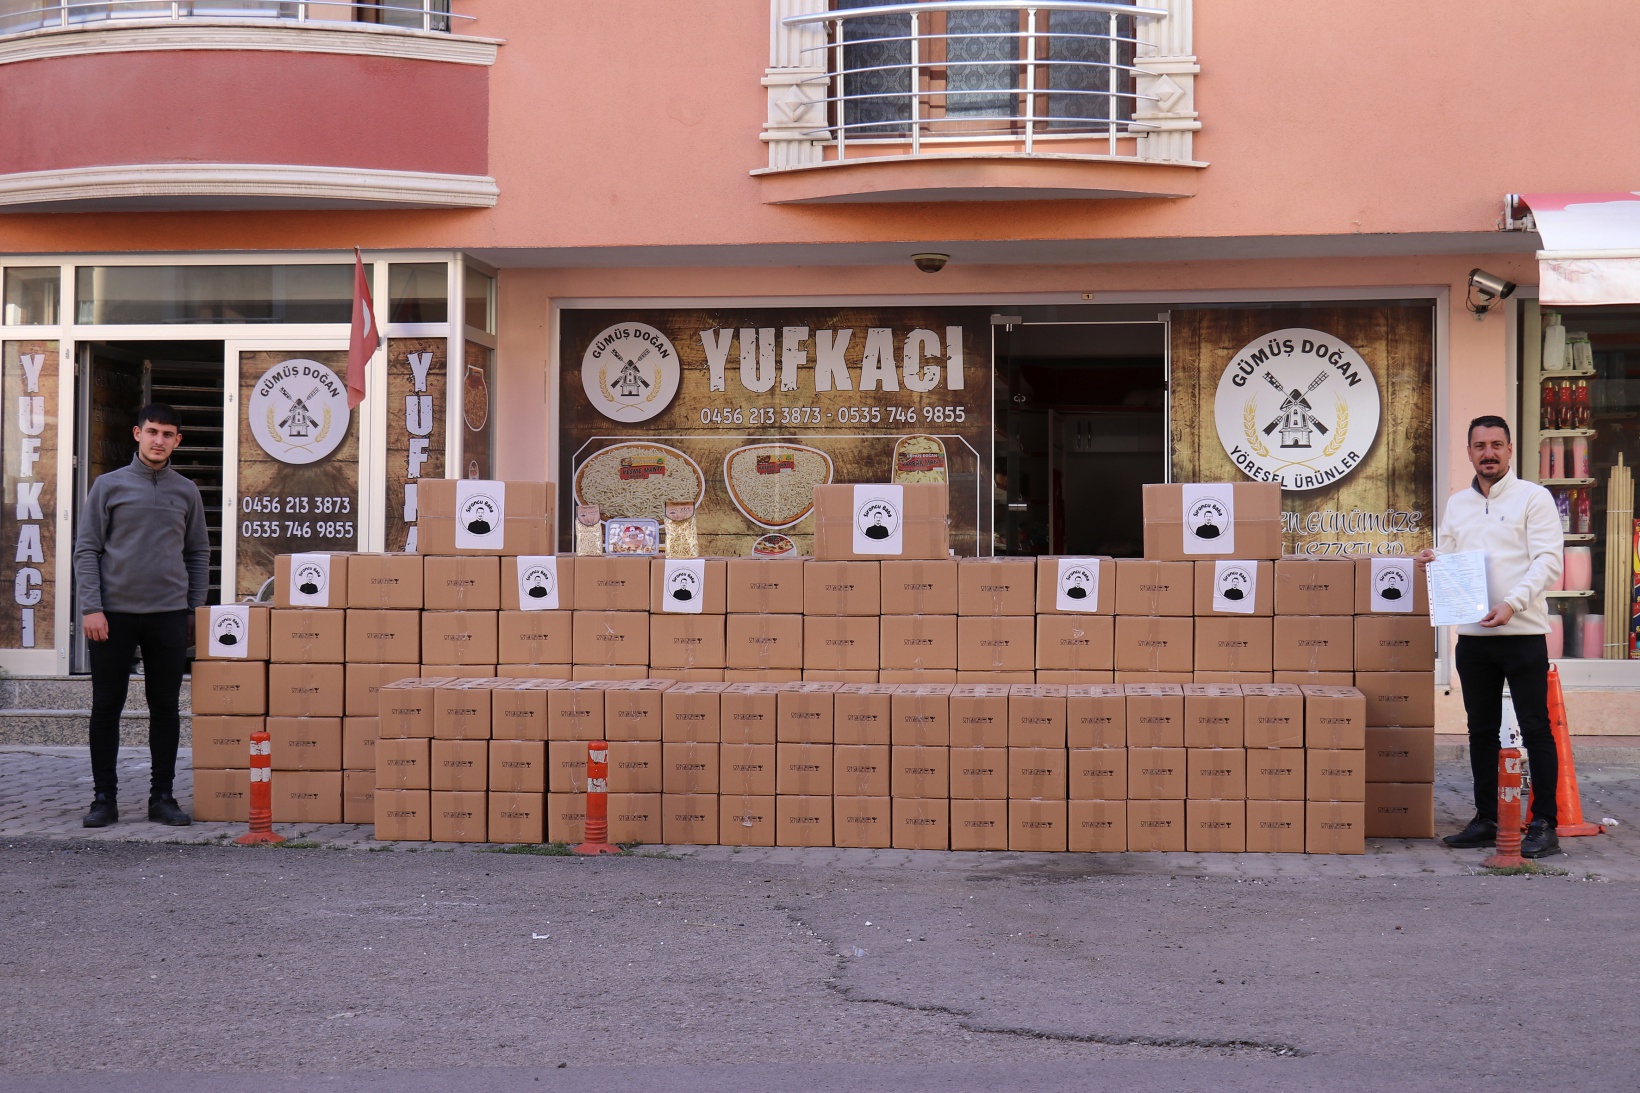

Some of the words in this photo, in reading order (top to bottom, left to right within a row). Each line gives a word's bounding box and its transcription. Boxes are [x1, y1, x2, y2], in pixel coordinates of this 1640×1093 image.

[592, 328, 630, 359] GÜMÜŞ
[633, 329, 670, 359] DOĞAN
[699, 325, 964, 393] YUFKACI
[1232, 338, 1295, 388] GÜMÜŞ
[1301, 339, 1362, 388] DOĞAN
[260, 365, 299, 398] GÜMÜŞ
[302, 366, 340, 398] DOĞAN
[700, 407, 743, 424] 0456
[749, 407, 775, 424] 213
[781, 407, 821, 424] 3873
[837, 406, 881, 424] 0535
[886, 406, 917, 424] 746
[923, 406, 966, 423] 9855
[1294, 451, 1360, 489] ÜRÜNLER
[14, 354, 46, 647] YUFKACI
[242, 496, 281, 513] 0456
[285, 496, 309, 513] 213
[314, 497, 350, 514] 3873
[242, 521, 280, 538] 0535
[285, 521, 312, 538] 746
[316, 521, 354, 538] 9855
